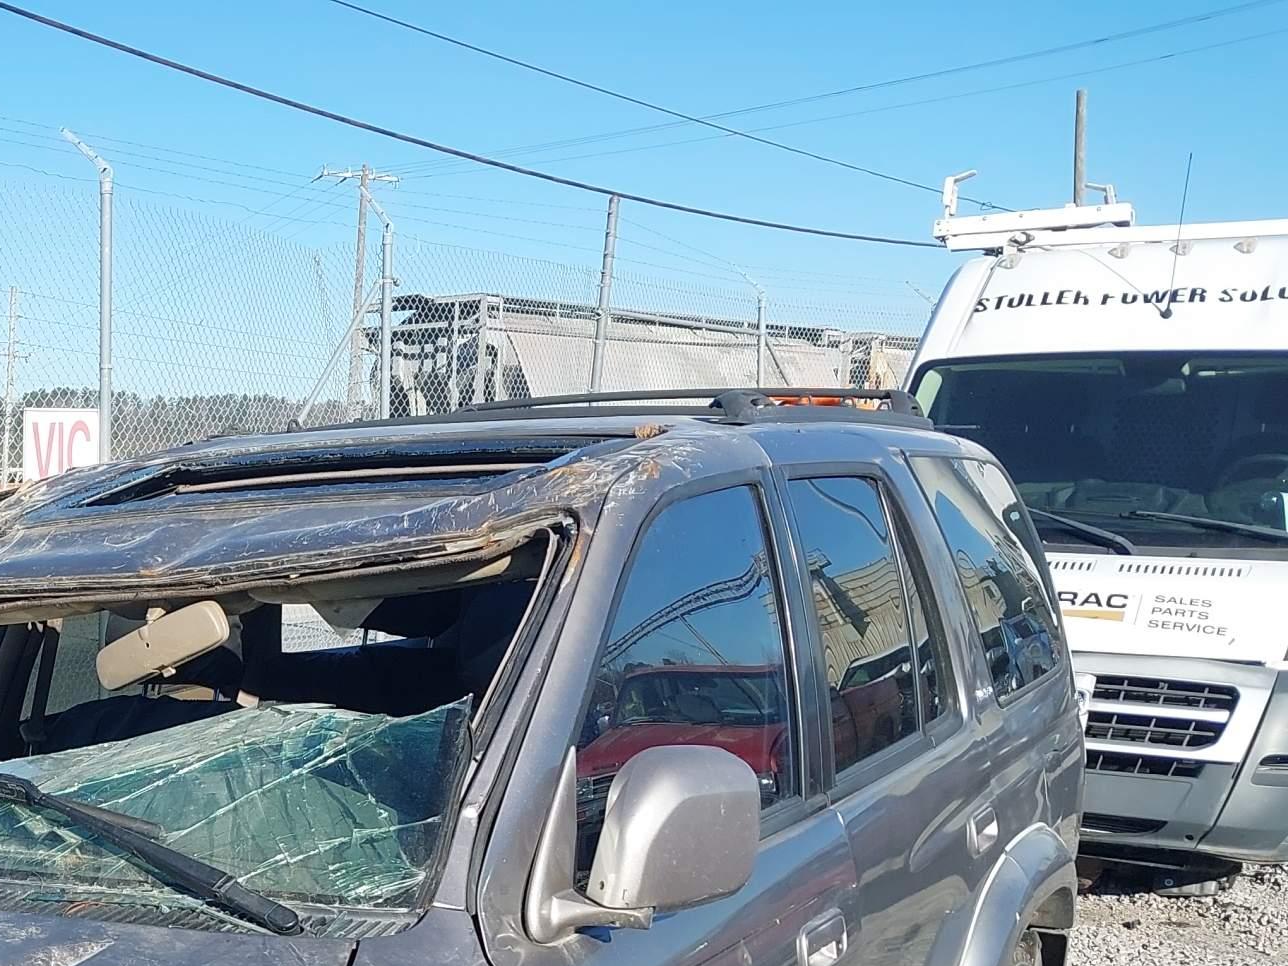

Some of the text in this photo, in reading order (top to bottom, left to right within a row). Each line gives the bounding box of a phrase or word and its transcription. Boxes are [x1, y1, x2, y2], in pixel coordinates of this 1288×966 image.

[1154, 594, 1213, 608] SALES
[1151, 606, 1210, 621] PARTS
[1147, 619, 1228, 637] SERVICE
